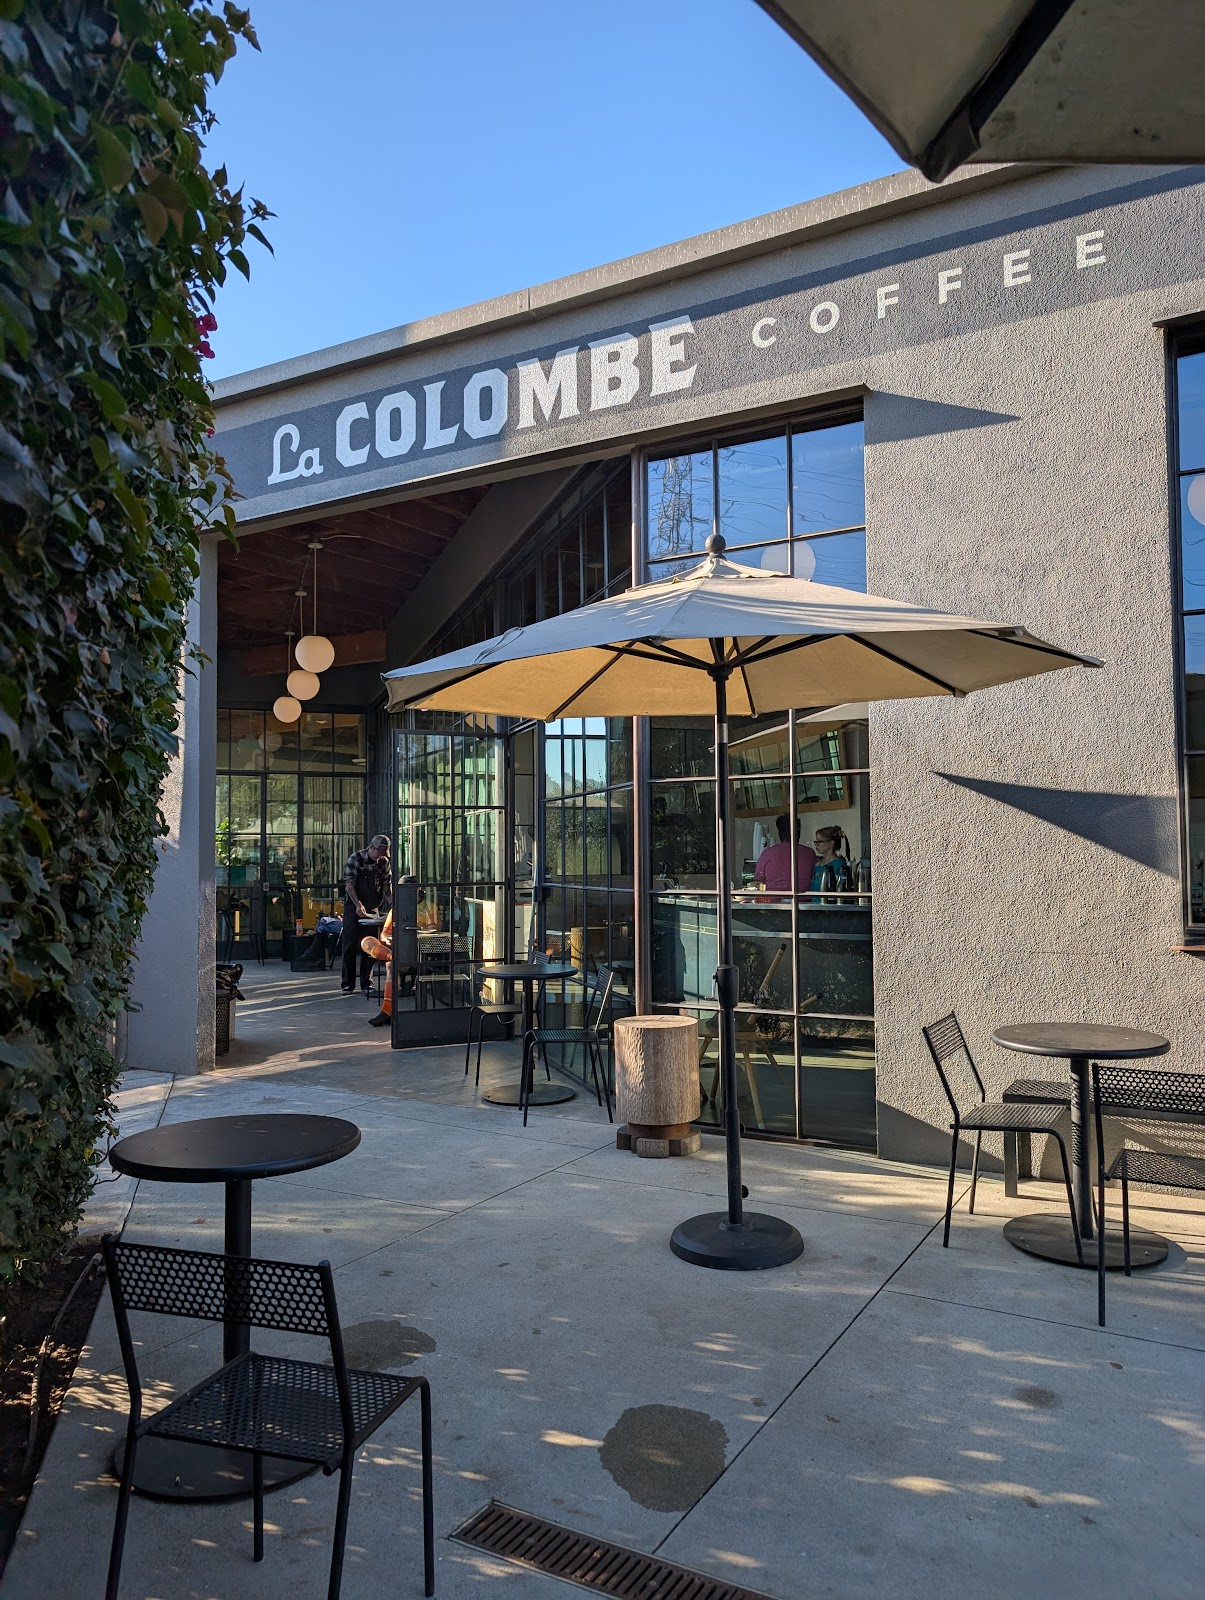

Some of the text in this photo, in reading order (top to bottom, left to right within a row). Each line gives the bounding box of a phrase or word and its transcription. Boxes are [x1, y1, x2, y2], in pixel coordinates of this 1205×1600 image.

[267, 230, 1106, 485] La COLOMBE COFFEE
